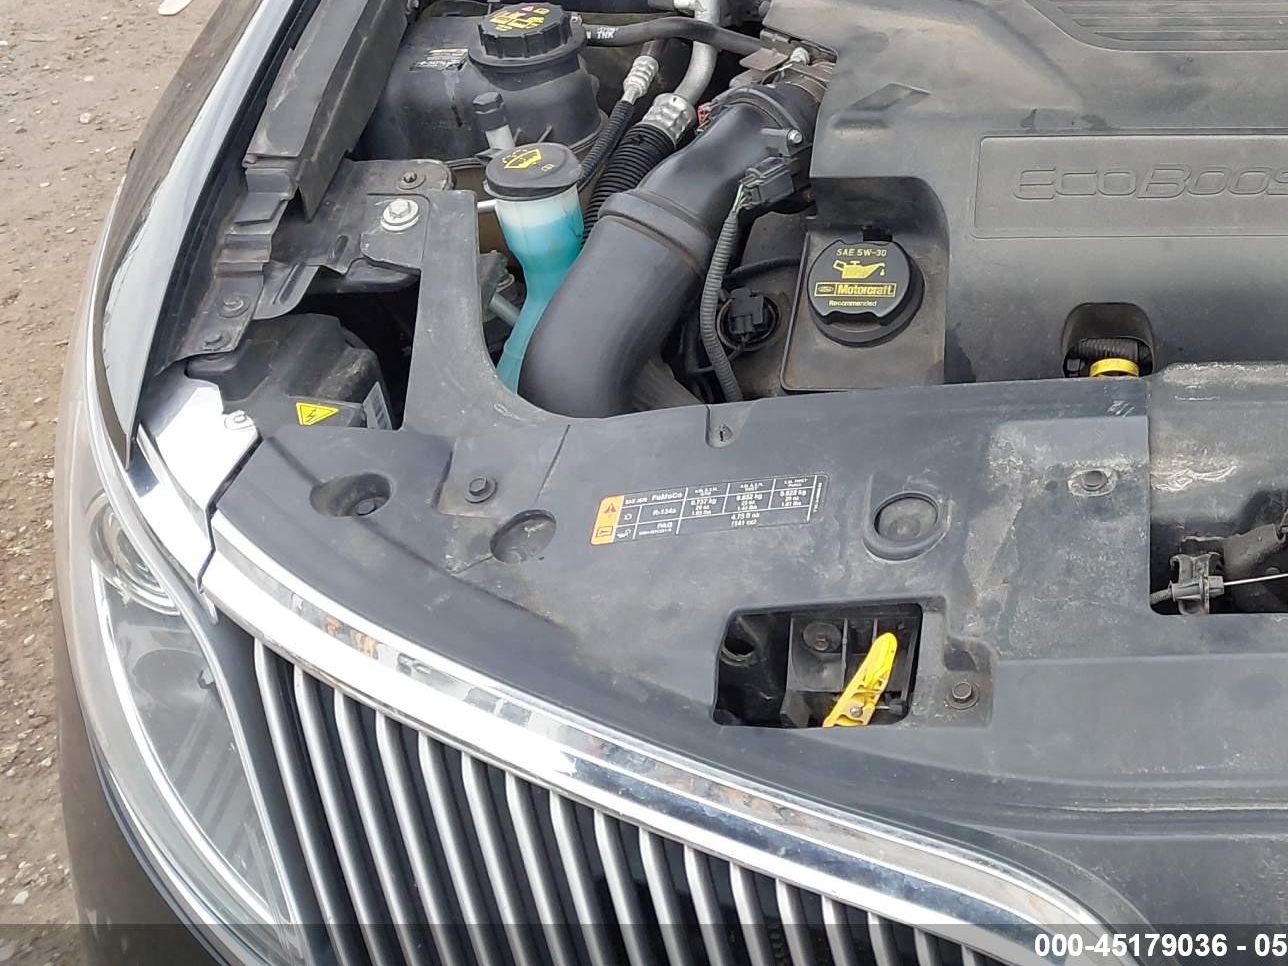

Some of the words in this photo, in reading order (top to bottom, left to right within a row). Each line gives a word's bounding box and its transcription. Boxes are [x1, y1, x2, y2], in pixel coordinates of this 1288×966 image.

[836, 248, 855, 257] SAE
[857, 248, 887, 257] 5W-30
[837, 283, 894, 296] Motorcraft
